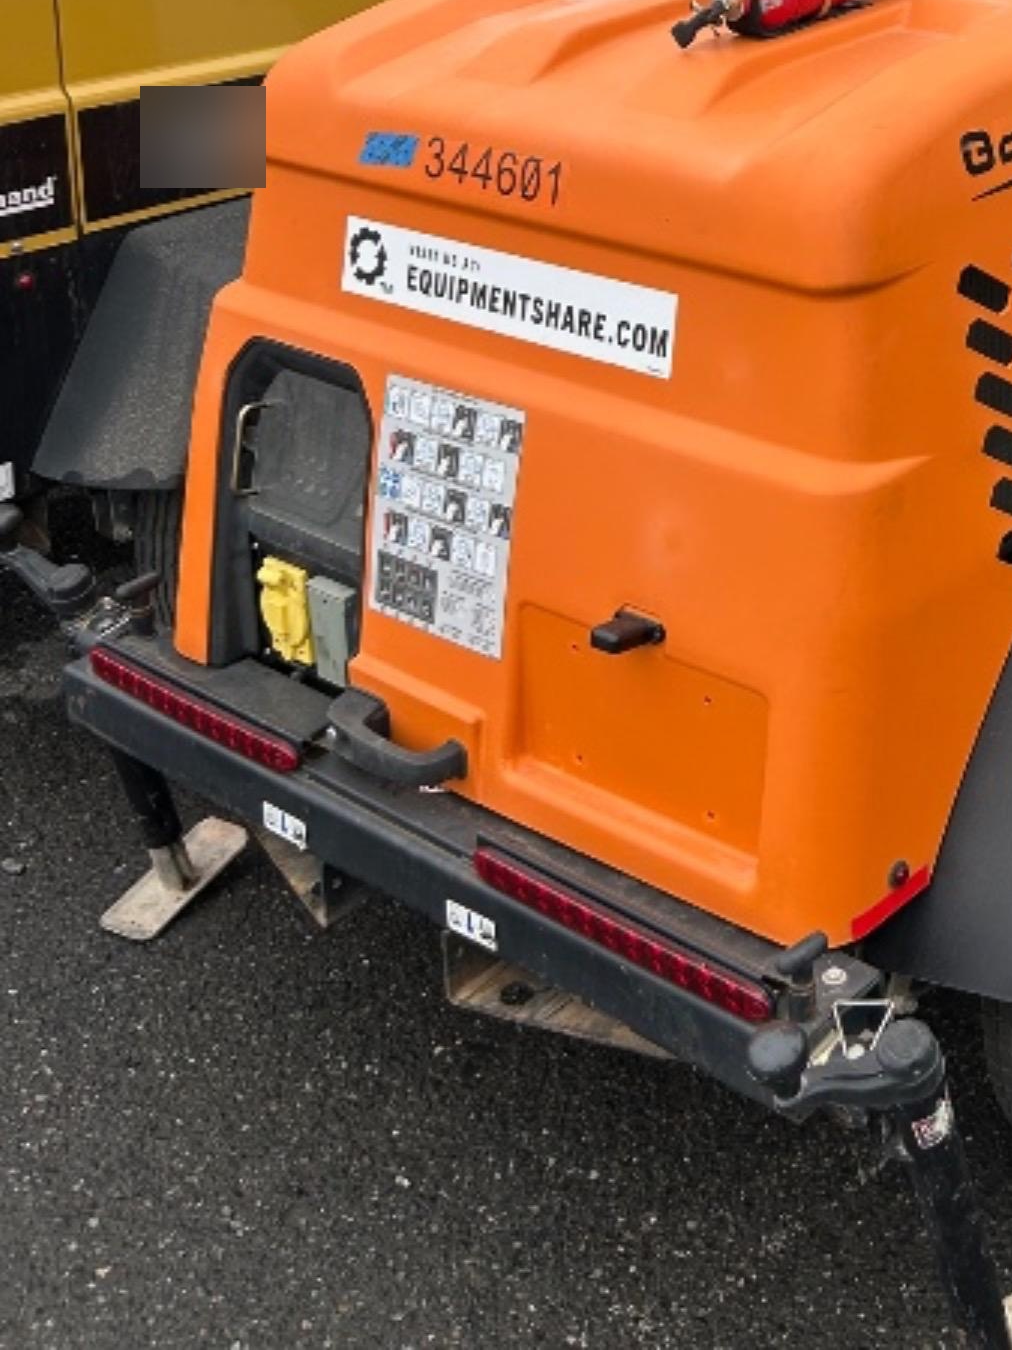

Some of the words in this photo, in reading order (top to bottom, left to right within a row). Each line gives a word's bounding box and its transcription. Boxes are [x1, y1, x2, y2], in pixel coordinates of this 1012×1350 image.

[0, 176, 56, 208] and
[425, 136, 562, 205] 344601
[406, 263, 669, 359] EQUIPMENTSHARE.COM
